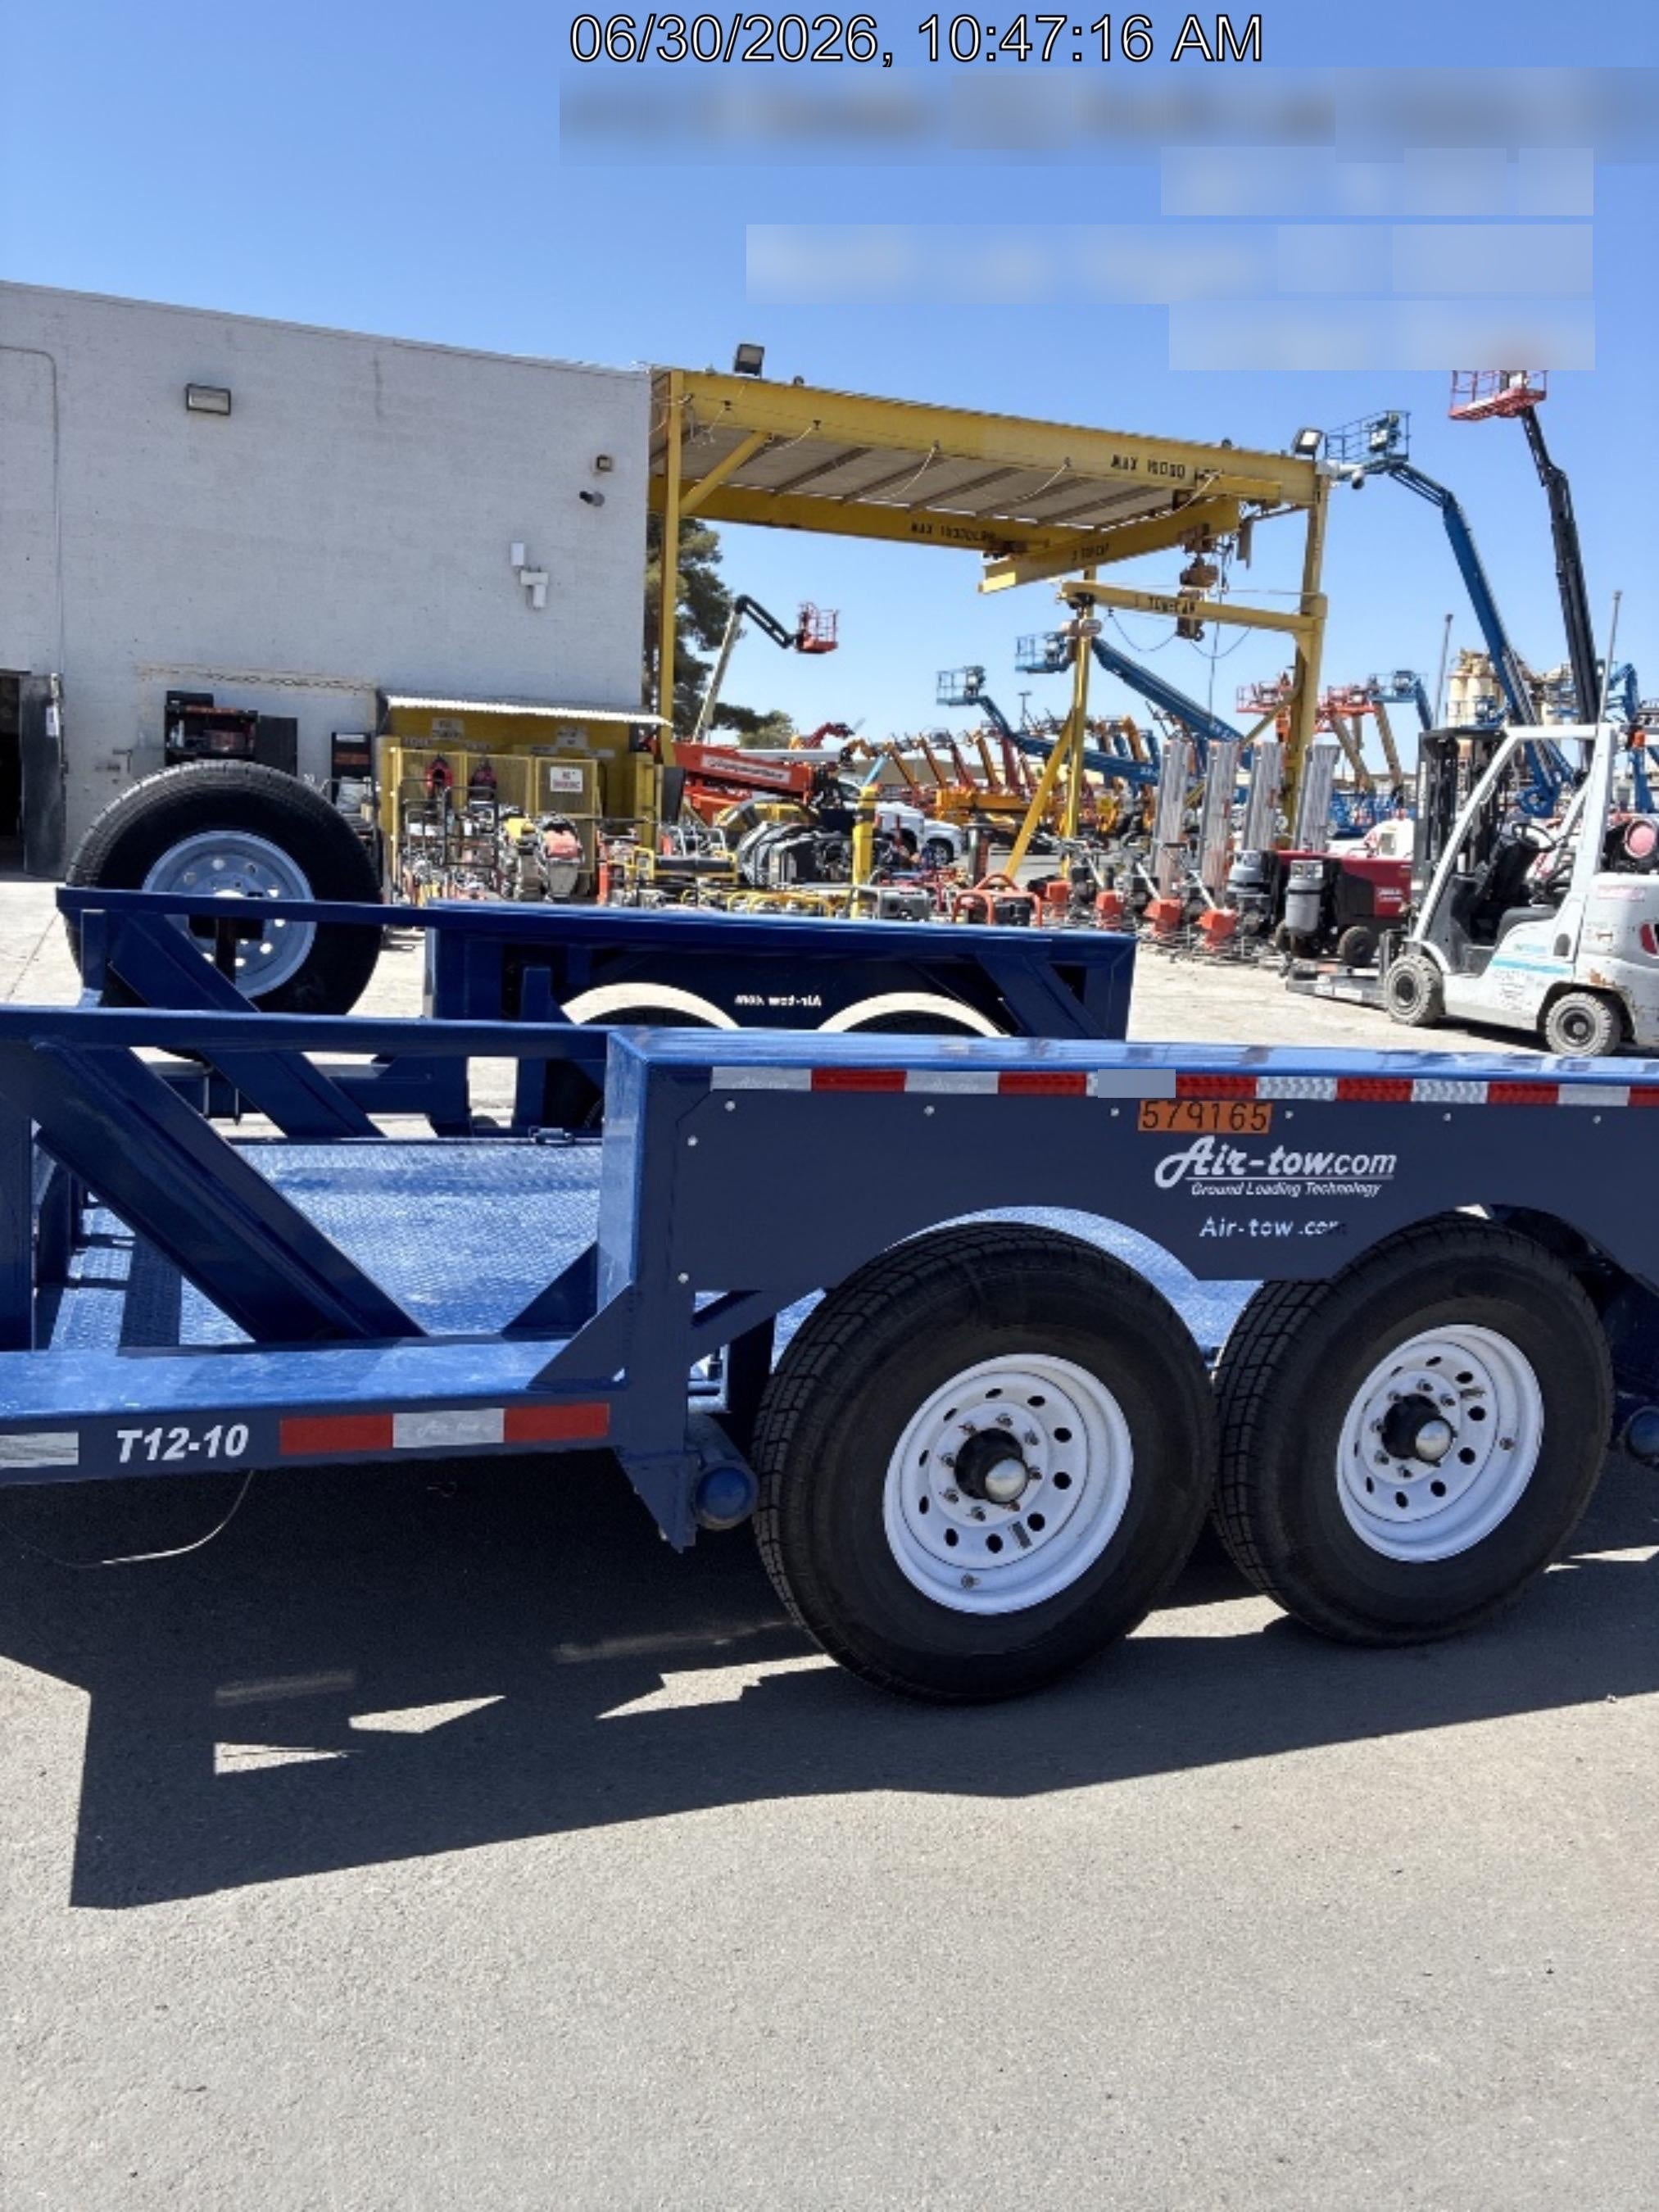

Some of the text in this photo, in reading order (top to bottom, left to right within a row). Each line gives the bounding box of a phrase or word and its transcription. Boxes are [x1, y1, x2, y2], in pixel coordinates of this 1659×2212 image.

[1141, 1102, 1267, 1131] 579165
[1154, 1135, 1398, 1189] Air-tow.com
[1191, 1181, 1383, 1199] Ground Loading Technology
[116, 1422, 249, 1463] T12-10
